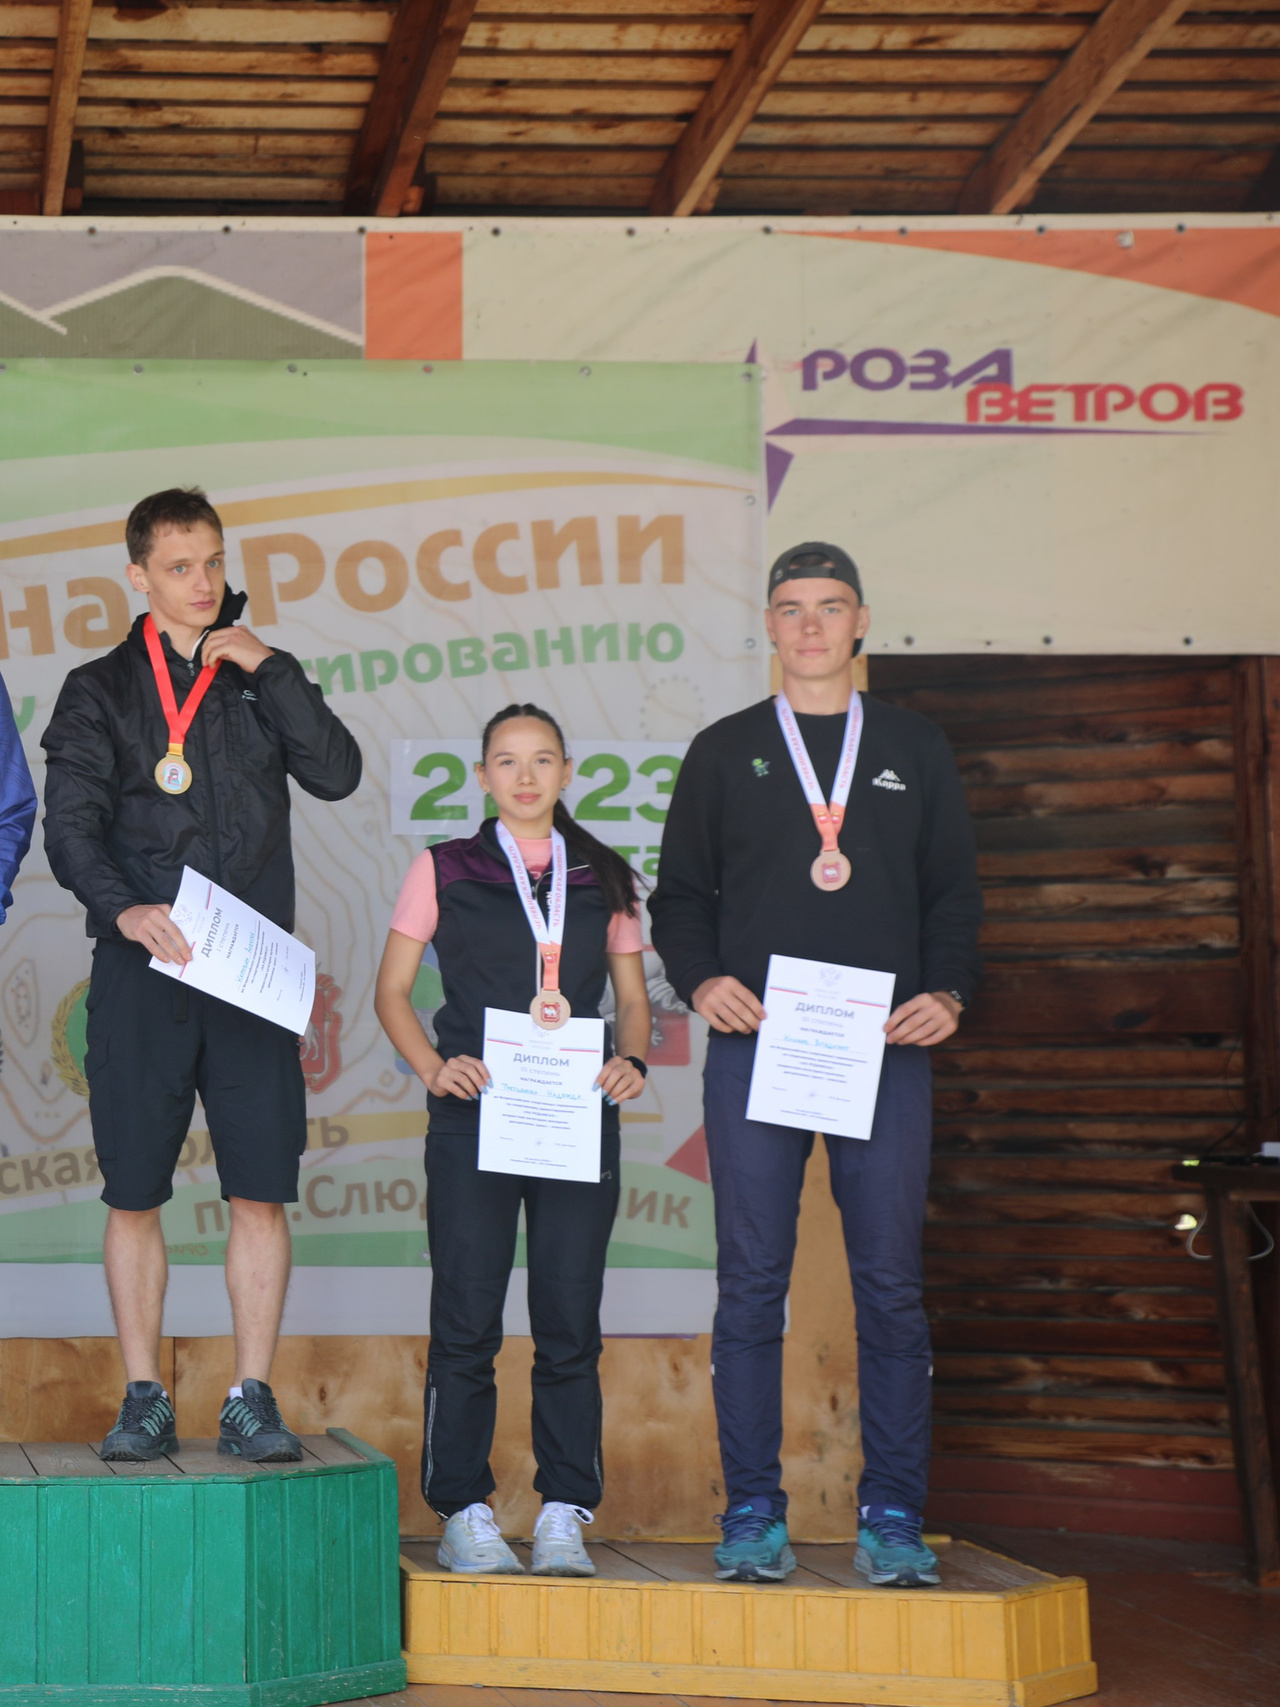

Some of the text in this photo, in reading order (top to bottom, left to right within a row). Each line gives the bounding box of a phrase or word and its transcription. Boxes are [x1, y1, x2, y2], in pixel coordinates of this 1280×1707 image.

[800, 348, 1013, 392] РОЗА
[965, 382, 1244, 424] ВЕТРОВ
[240, 514, 686, 628] России
[872, 778, 906, 791] Kappa
[201, 907, 223, 958] ДИПЛОМ
[226, 923, 240, 959] НАГРАЖДАЕТСЯ
[795, 1002, 855, 1019] ДИПЛОМ
[513, 1053, 570, 1067] ДИПЛОМ
[520, 1077, 563, 1086] НАГРАЖДАЕТСЯ
